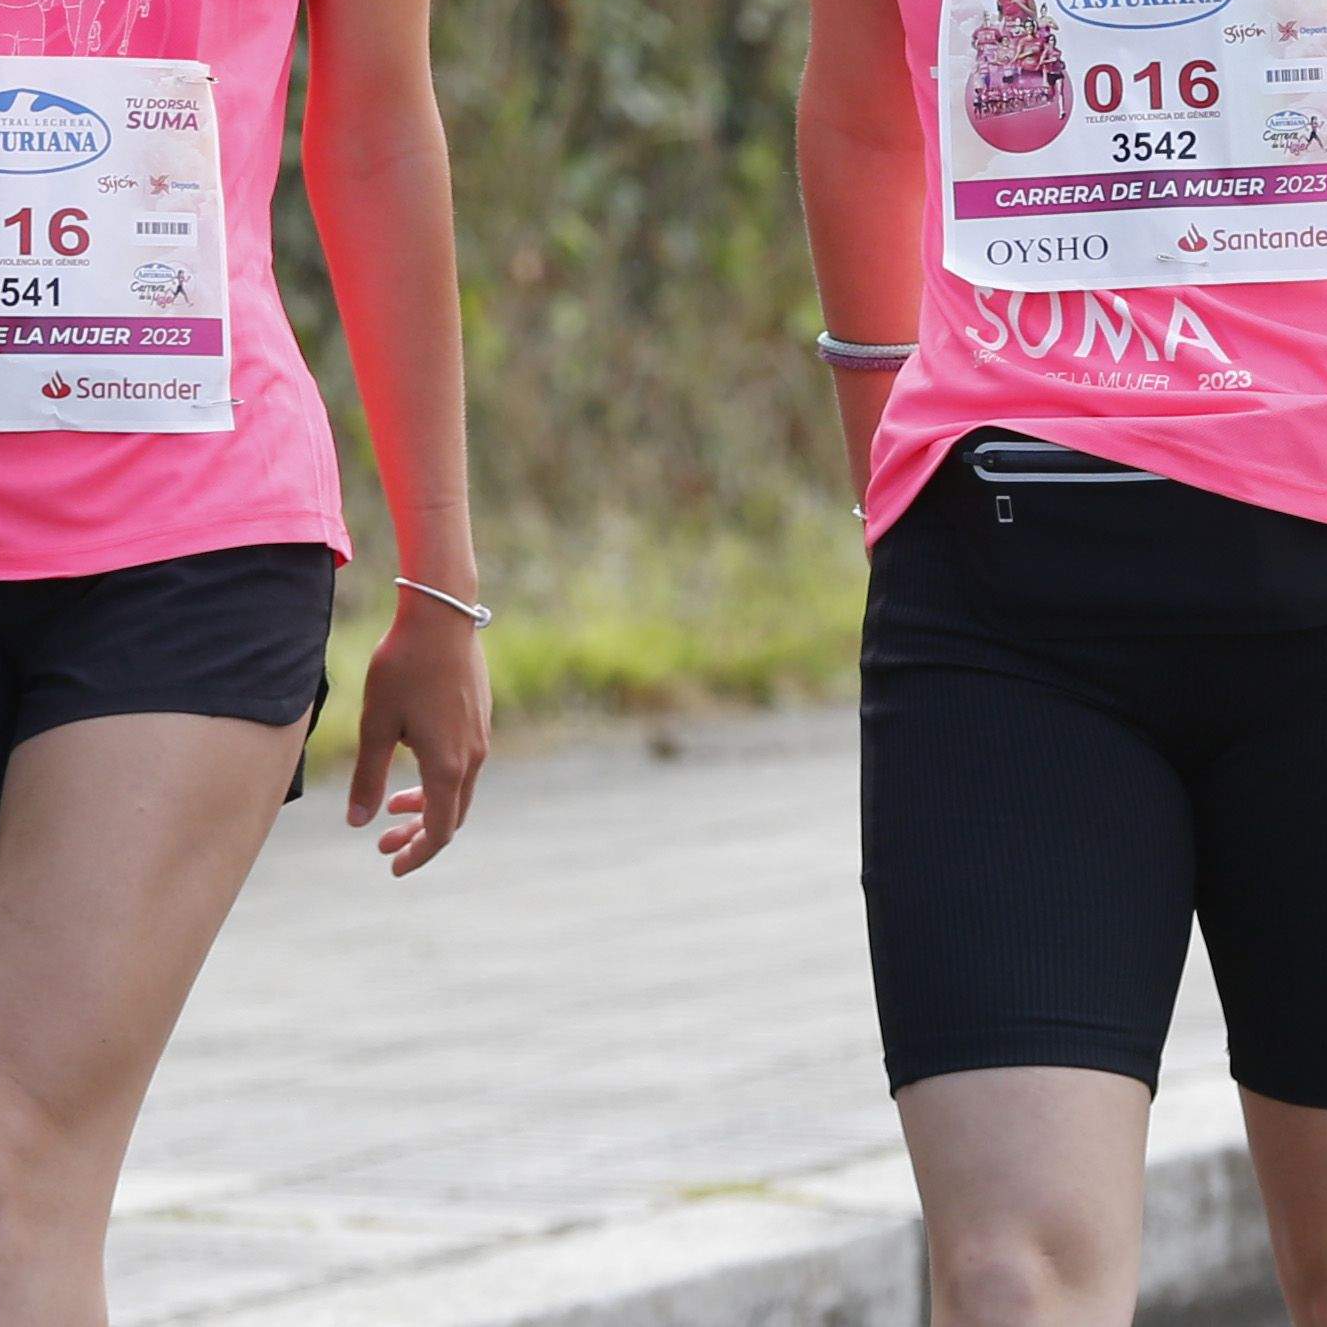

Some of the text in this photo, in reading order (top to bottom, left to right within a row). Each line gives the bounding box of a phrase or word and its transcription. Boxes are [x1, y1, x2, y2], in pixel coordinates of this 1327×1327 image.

[1083, 59, 1220, 114] 016
[126, 98, 200, 111] TU DORSAL
[35, 118, 93, 128] LECHERA
[126, 110, 199, 131] SUMA
[1128, 112, 1173, 122] VIOLENCIA
[1174, 111, 1185, 120] DE
[1112, 130, 1197, 163] 3542
[995, 174, 1327, 208] CARRERA DE LA MUJER 2023
[987, 234, 1108, 265] OYSHO
[42, 258, 54, 267] DE
[13, 328, 44, 345] LA
[49, 327, 131, 346] MUJER
[140, 328, 192, 346] 2023
[76, 377, 202, 400] Santander
[1099, 372, 1170, 390] MUJER
[1198, 370, 1252, 391] 2023
